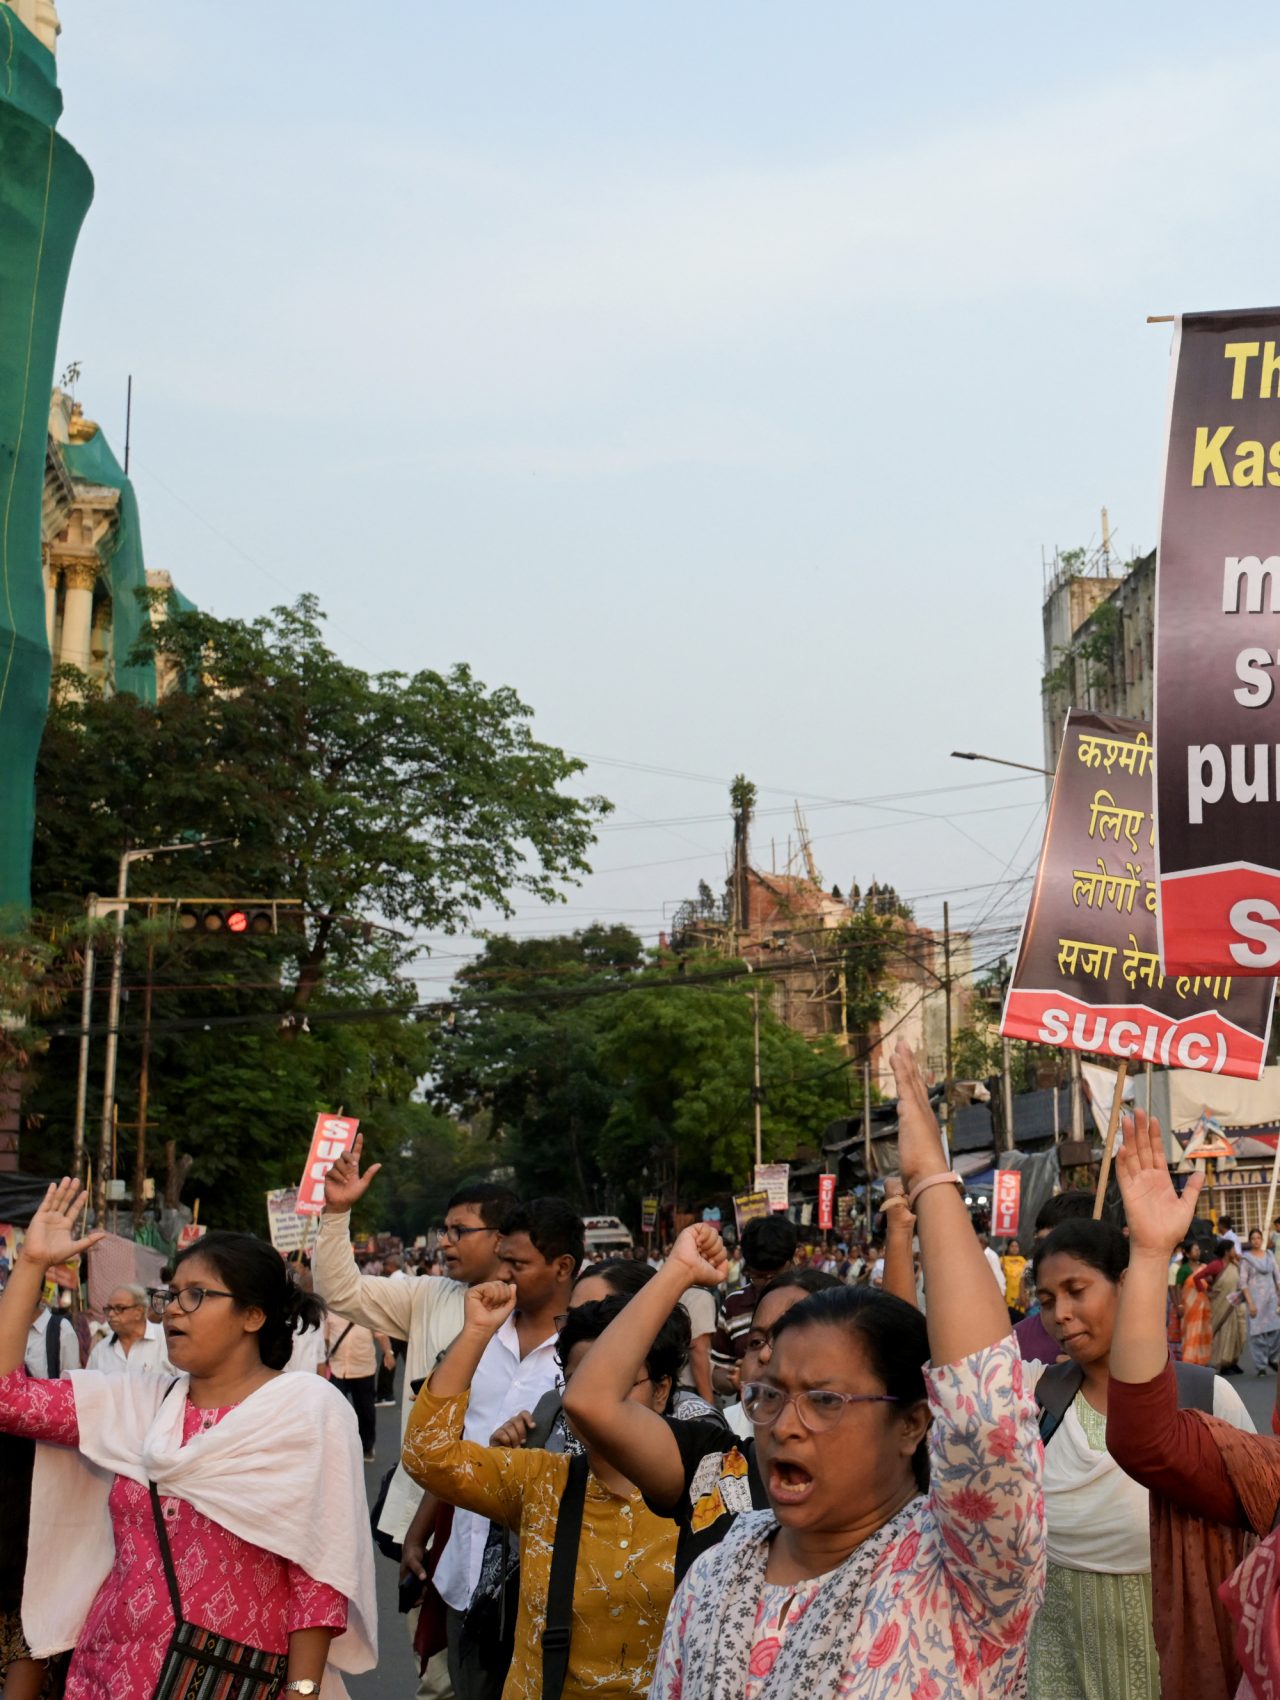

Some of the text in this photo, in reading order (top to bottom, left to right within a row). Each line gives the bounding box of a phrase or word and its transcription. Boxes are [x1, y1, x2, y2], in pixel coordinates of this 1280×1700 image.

[1088, 789, 1145, 854] लिए
[1072, 858, 1141, 914] लोगों
[1057, 938, 1118, 981] सजा
[1122, 934, 1165, 991] देना
[1038, 1008, 1228, 1075] SUCI(C)
[822, 1179, 833, 1225] SUCI
[1001, 1173, 1016, 1228] SUCI
[1212, 1170, 1263, 1186] KATA
